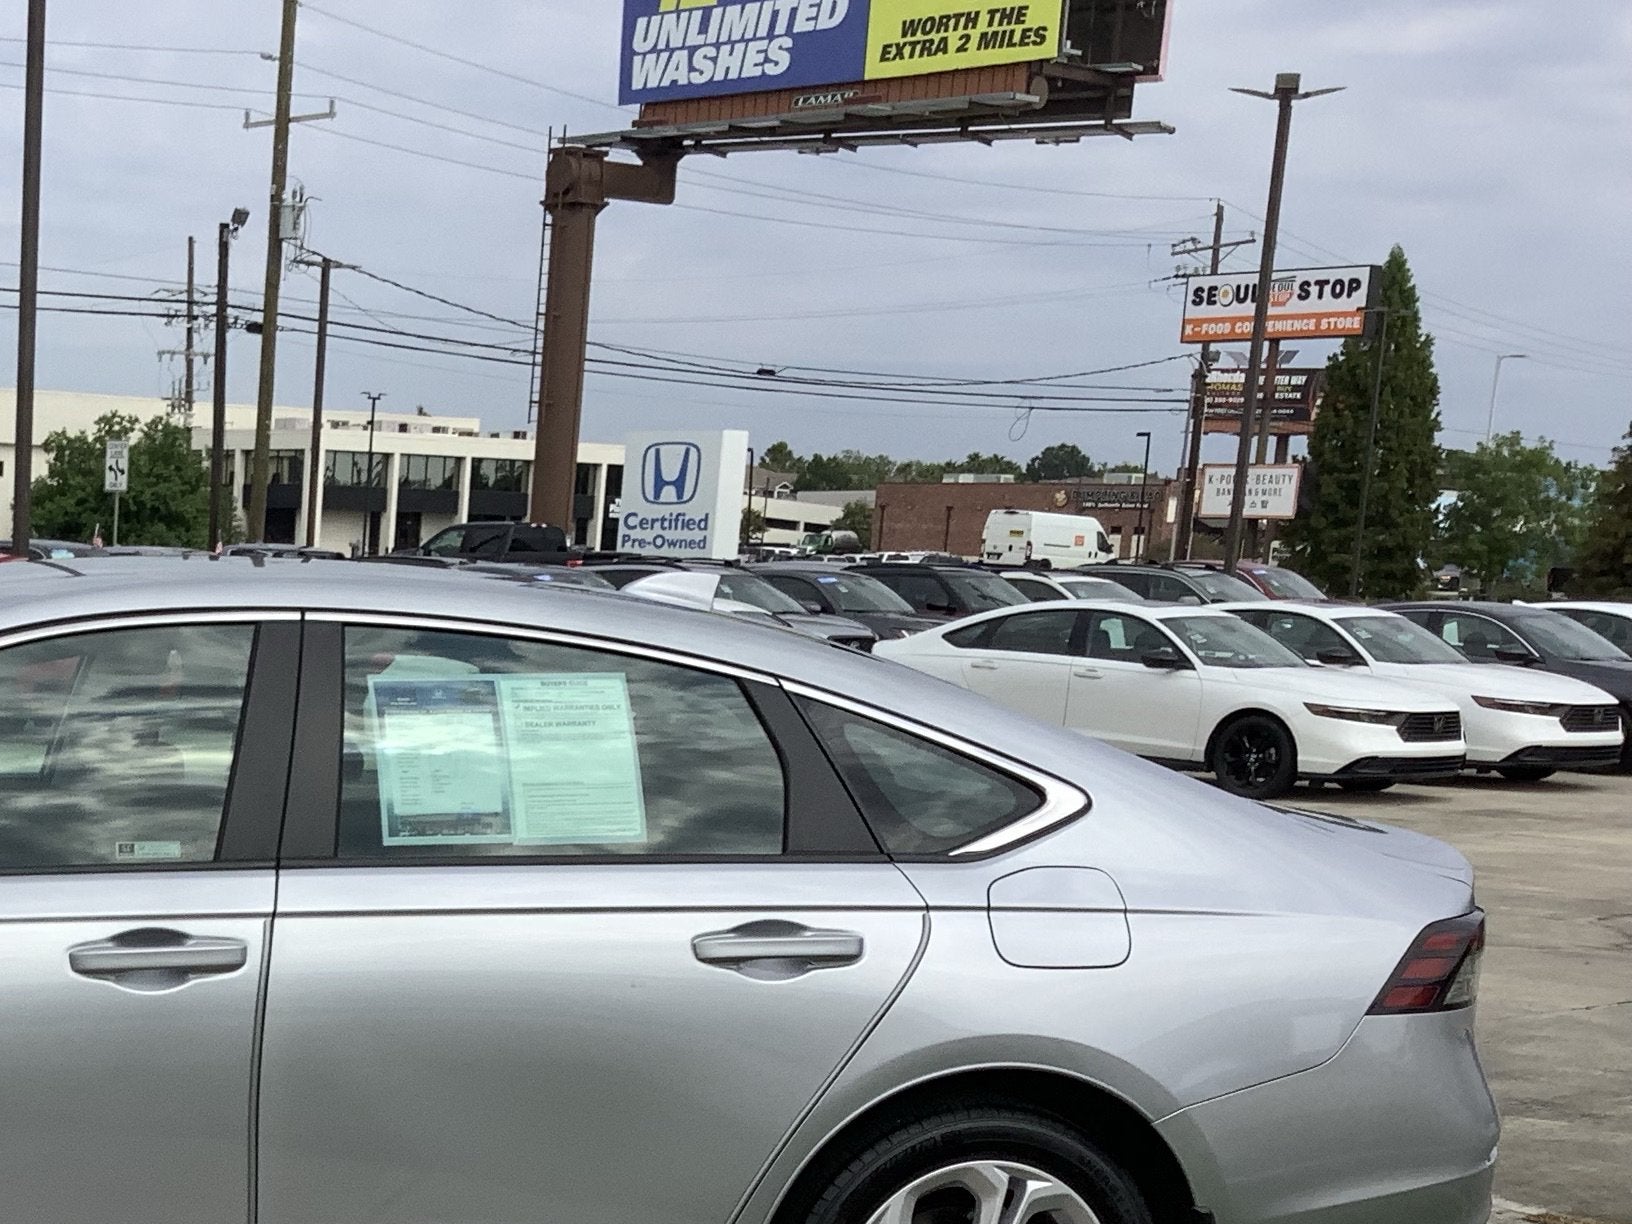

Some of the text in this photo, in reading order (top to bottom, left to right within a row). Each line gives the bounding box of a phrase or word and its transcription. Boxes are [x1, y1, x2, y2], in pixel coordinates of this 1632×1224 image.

[632, 0, 850, 53] UNLIMITED
[900, 5, 1029, 39] WORTH THE
[879, 25, 1048, 63] EXTRA 2 MILES
[631, 36, 793, 91] WASHES
[1297, 277, 1362, 301] STOP
[1185, 322, 1232, 335] K-FOOD
[1320, 316, 1361, 330] STORE
[1247, 473, 1294, 485] -BEAUTY
[623, 511, 710, 531] Certified
[621, 534, 707, 550] Pre-Owned
